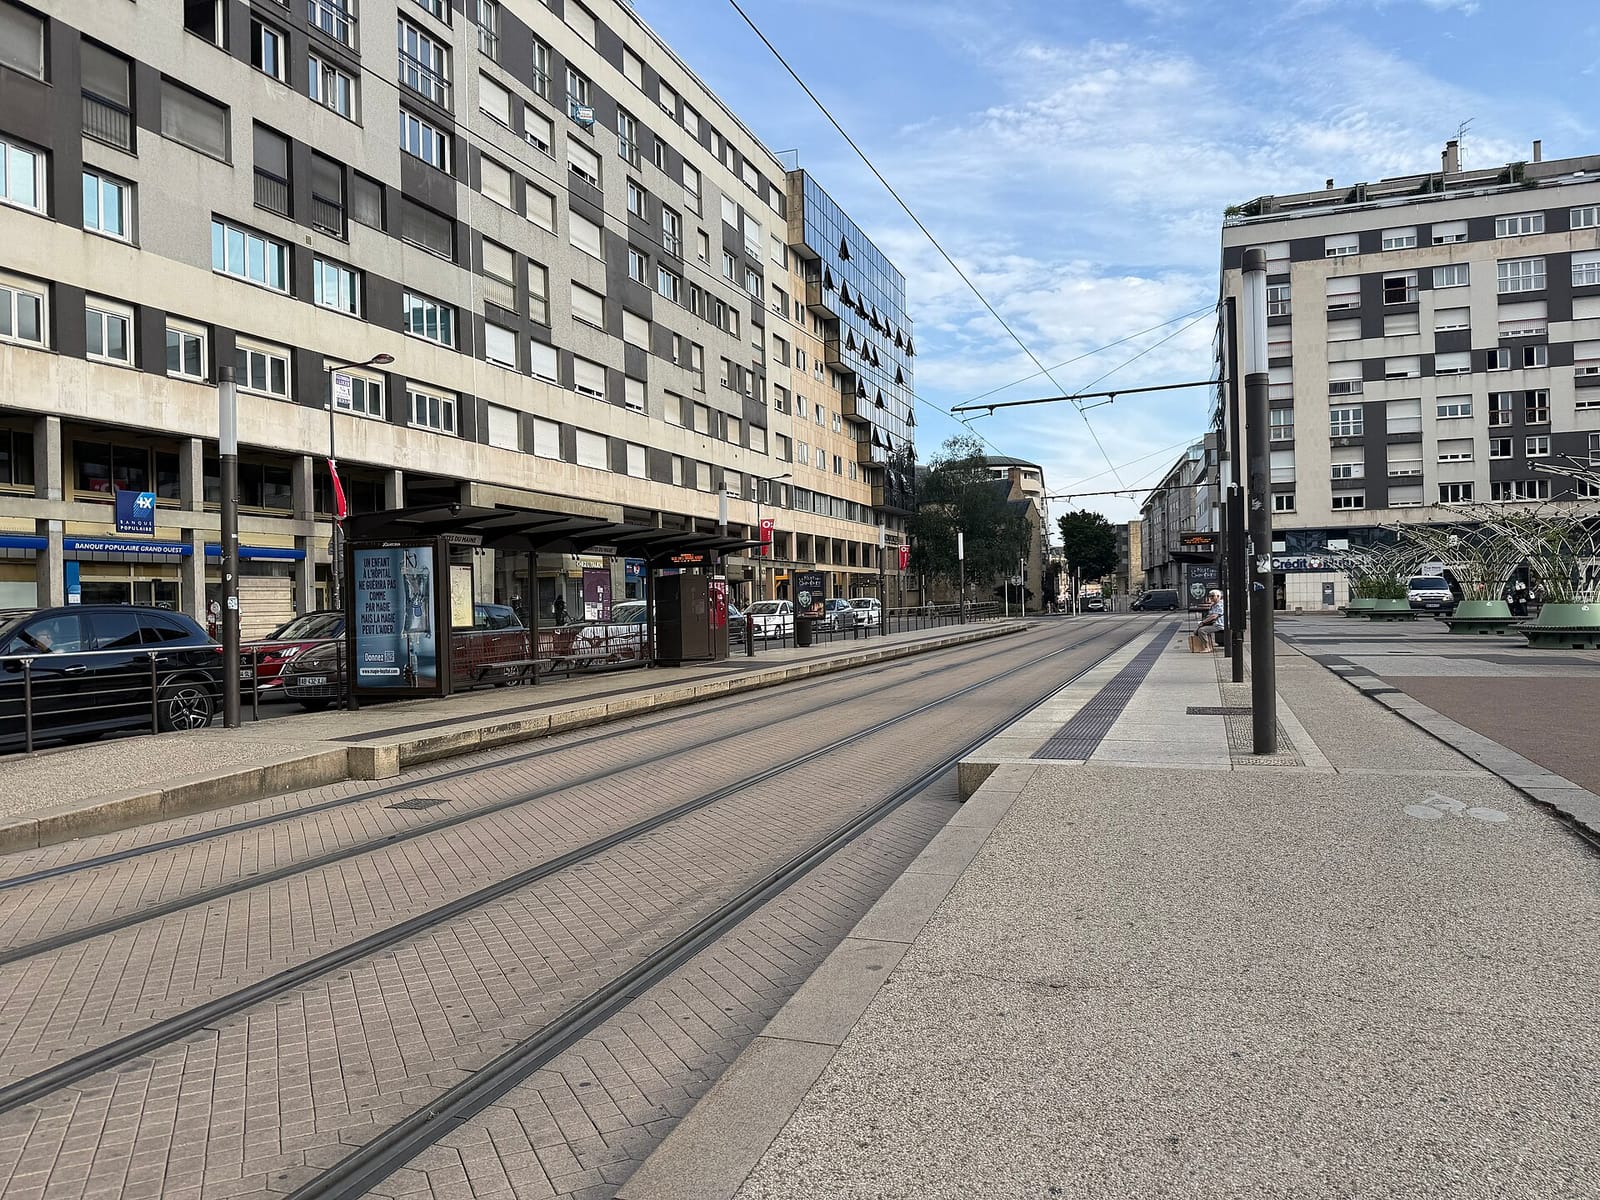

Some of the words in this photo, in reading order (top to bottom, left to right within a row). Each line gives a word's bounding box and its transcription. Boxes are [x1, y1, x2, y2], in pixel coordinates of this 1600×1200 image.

[364, 558, 370, 568] UN
[371, 557, 390, 567] ENFANT
[1272, 558, 1308, 569] Crédit
[359, 580, 366, 590] NE
[387, 579, 396, 589] PAS
[369, 591, 386, 601] COMME
[366, 602, 375, 612] PAR
[376, 602, 390, 612] MAGIE
[361, 613, 372, 623] MAIS
[374, 613, 379, 623] LA
[379, 613, 395, 623] MAGIE
[362, 625, 375, 634] PEUT
[365, 653, 384, 662] Donnez
